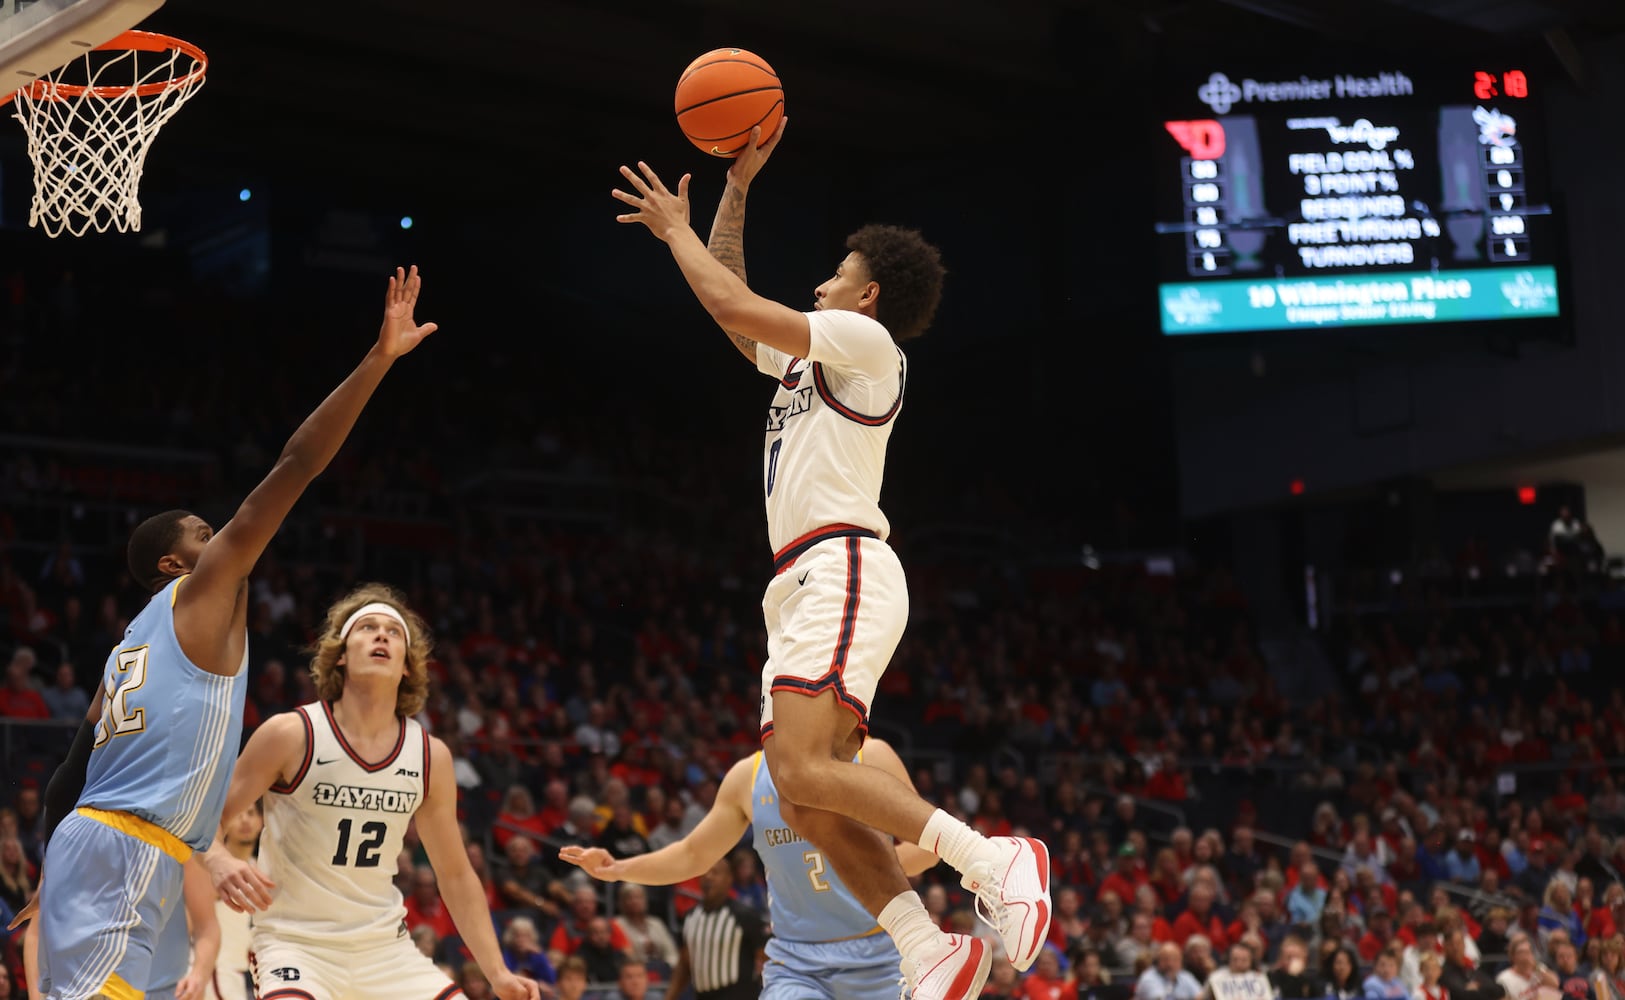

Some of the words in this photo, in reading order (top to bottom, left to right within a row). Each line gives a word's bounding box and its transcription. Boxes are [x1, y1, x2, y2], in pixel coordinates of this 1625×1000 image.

[1242, 76, 1331, 102] Premier
[1334, 71, 1413, 98] Health
[1289, 152, 1343, 174] FIELD
[1343, 151, 1395, 172] GOAL
[1304, 174, 1321, 195] 3
[1321, 172, 1377, 194] POINT
[1301, 195, 1405, 221] REBOUNDS
[1288, 221, 1339, 245] FREE
[1338, 218, 1421, 242] THROWS
[1298, 242, 1414, 268] TURNOVERS
[1247, 284, 1276, 309] 10
[1277, 280, 1408, 307] Wilmington
[1411, 276, 1472, 301] Place
[313, 783, 417, 813] DAYTON
[332, 819, 387, 867] 12
[765, 827, 808, 847] CEDA
[803, 851, 830, 893] 2
